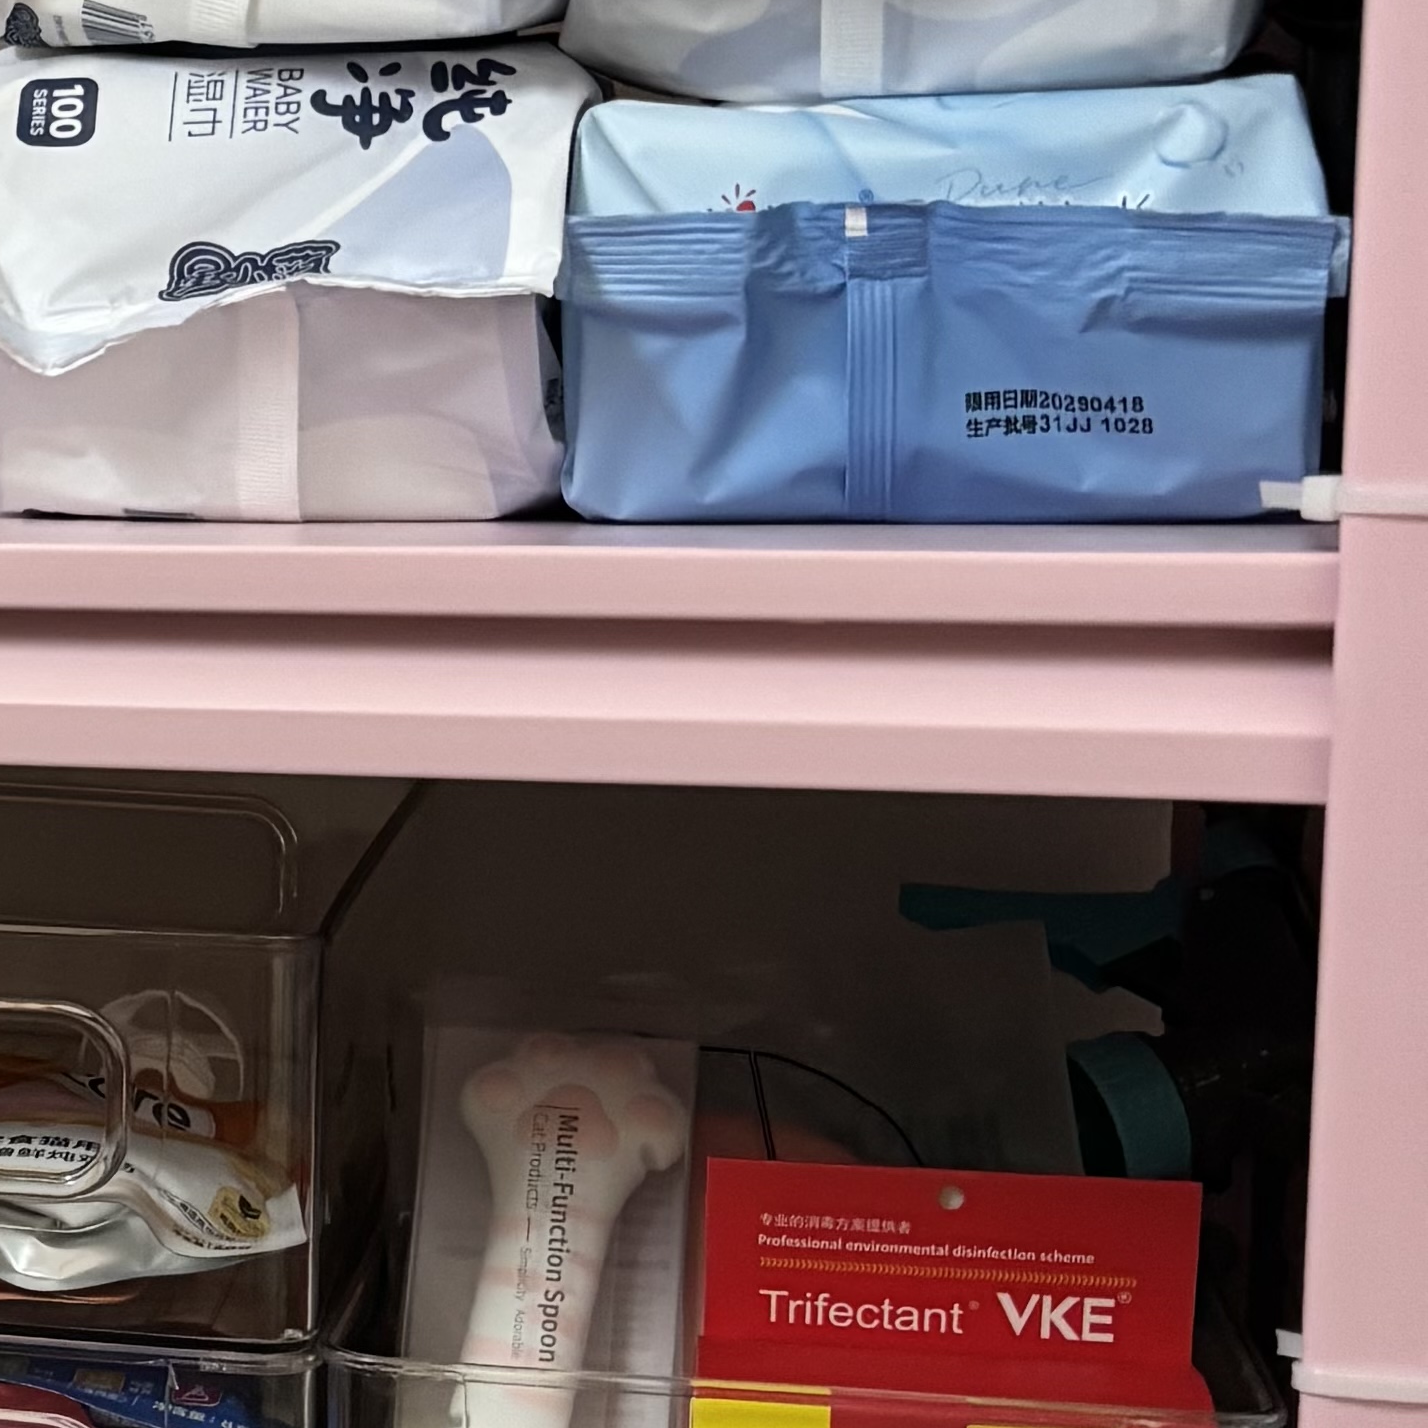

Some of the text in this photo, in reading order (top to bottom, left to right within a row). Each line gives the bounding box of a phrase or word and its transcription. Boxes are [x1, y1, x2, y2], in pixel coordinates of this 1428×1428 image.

[28, 88, 47, 137] SERIES
[48, 84, 84, 140] 100
[242, 68, 272, 135] WAIER
[271, 68, 305, 135] BABY
[310, 58, 517, 150] 纯净
[1100, 418, 1154, 434] 1028
[537, 1114, 580, 1363] Multi-Function Spoon
[757, 1233, 1096, 1265] Professional environmental disinfection scheme
[759, 1288, 1115, 1343] Trifectant VKE
